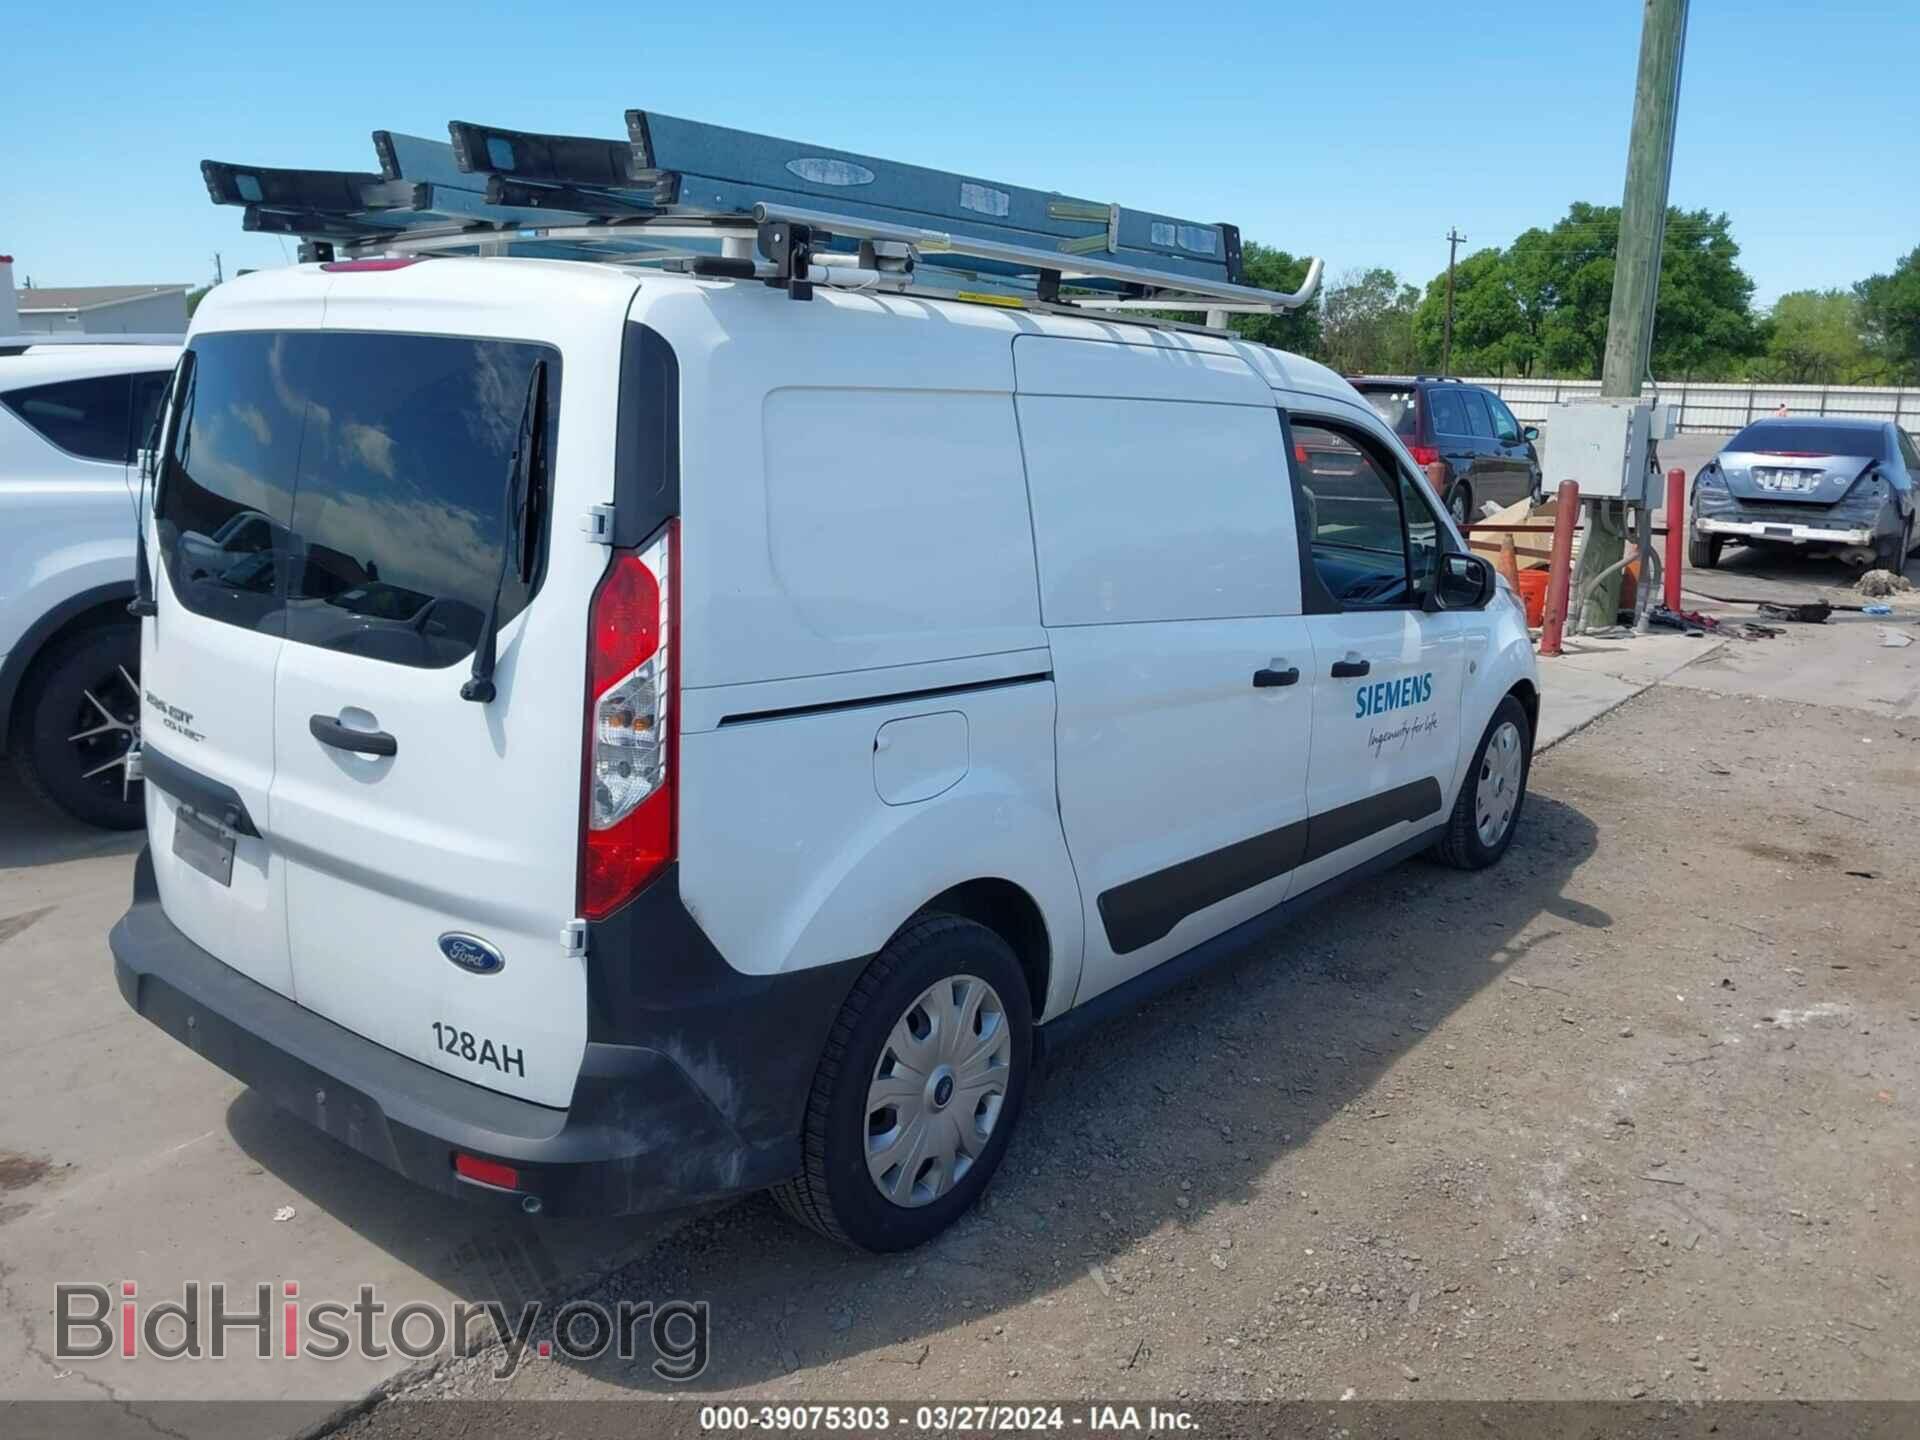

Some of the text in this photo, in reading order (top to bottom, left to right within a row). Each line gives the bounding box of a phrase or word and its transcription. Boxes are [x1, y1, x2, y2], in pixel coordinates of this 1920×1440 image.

[1355, 672, 1433, 719] SIEMENS
[448, 941, 485, 967] Ford
[432, 1021, 525, 1077] 128AH
